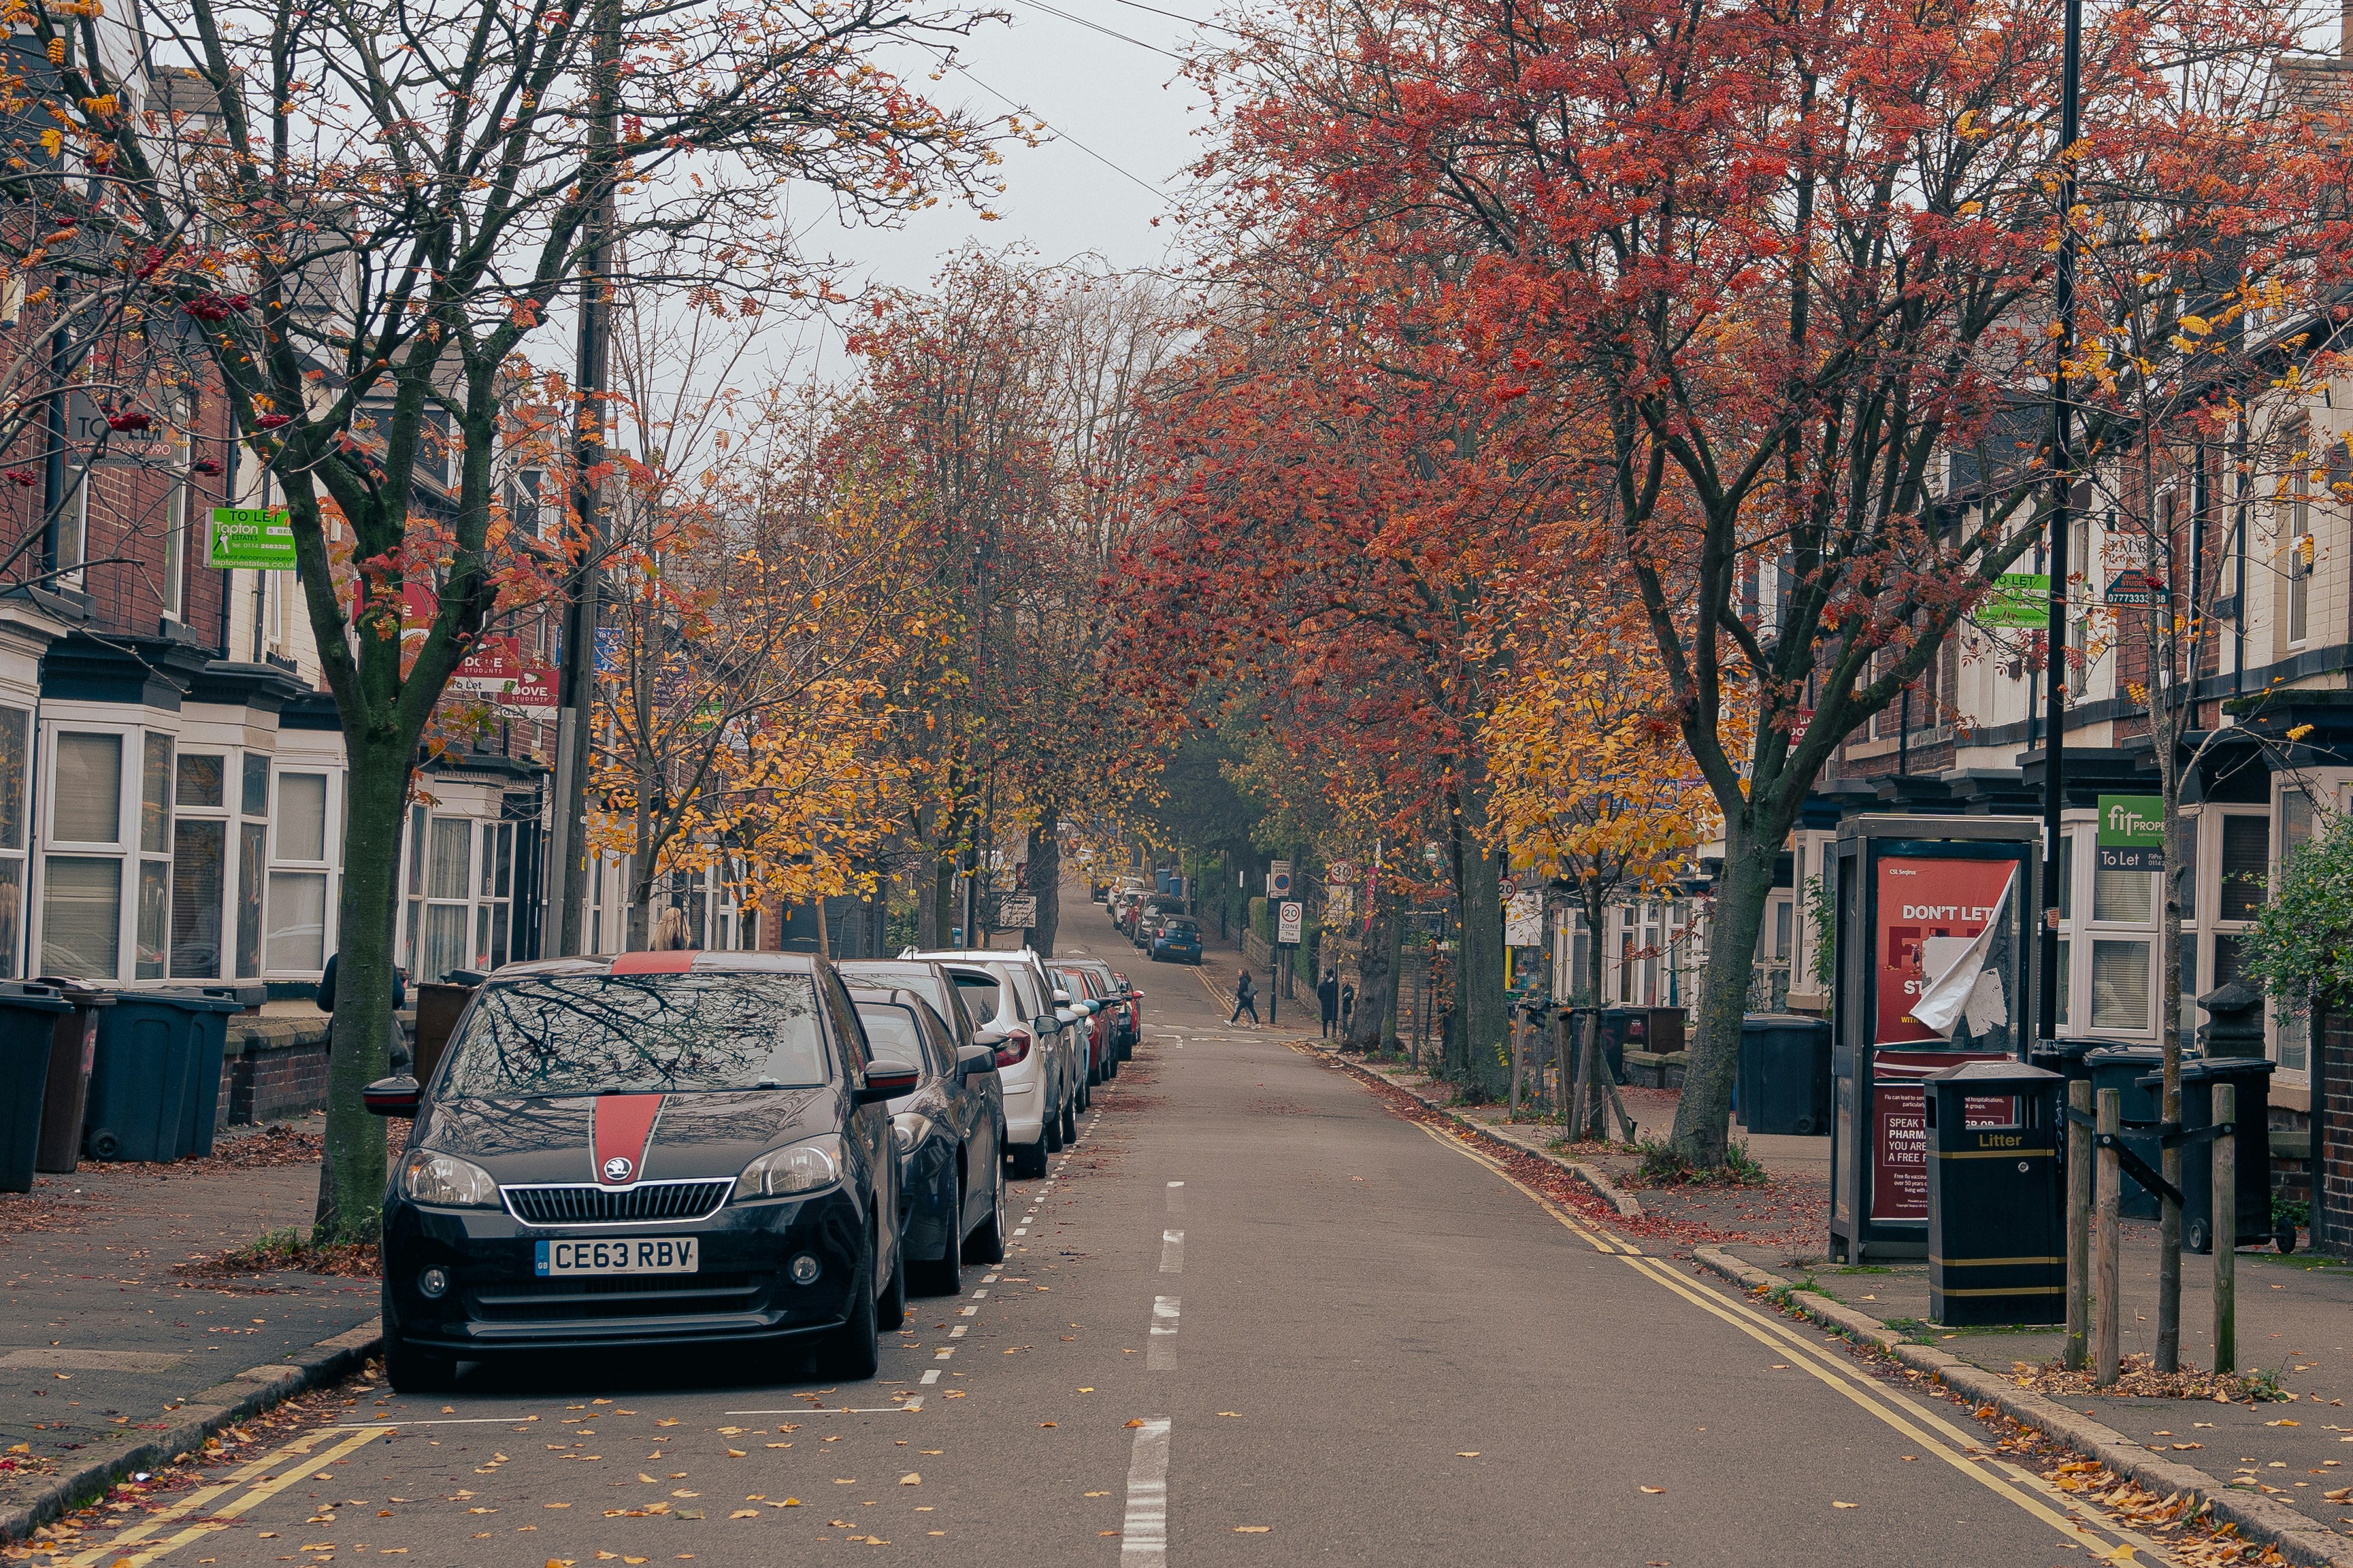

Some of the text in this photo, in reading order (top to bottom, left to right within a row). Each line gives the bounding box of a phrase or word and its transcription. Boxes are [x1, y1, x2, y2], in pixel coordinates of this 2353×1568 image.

[229, 510, 280, 522] TO LET
[214, 521, 259, 535] Tapton
[213, 559, 296, 569] taptonestates.co.uk
[2012, 576, 2035, 586] LET
[465, 657, 503, 668] DOE
[466, 681, 482, 690] Let
[512, 686, 548, 696] DOVE
[2107, 805, 2165, 837] fit PROPE
[2101, 851, 2139, 866] To Let
[1498, 884, 1513, 895] 20
[1284, 909, 1298, 917] 20
[1903, 905, 1994, 921] DON'T LET
[1890, 1118, 1919, 1128] SPEAK
[1889, 1141, 1926, 1151] YOU ARE
[1979, 1134, 2022, 1147] Litter
[1888, 1152, 1895, 1162] A
[1897, 1153, 1920, 1163] FREE
[556, 1241, 691, 1269] CE63 RBV
[538, 1261, 548, 1270] GB
